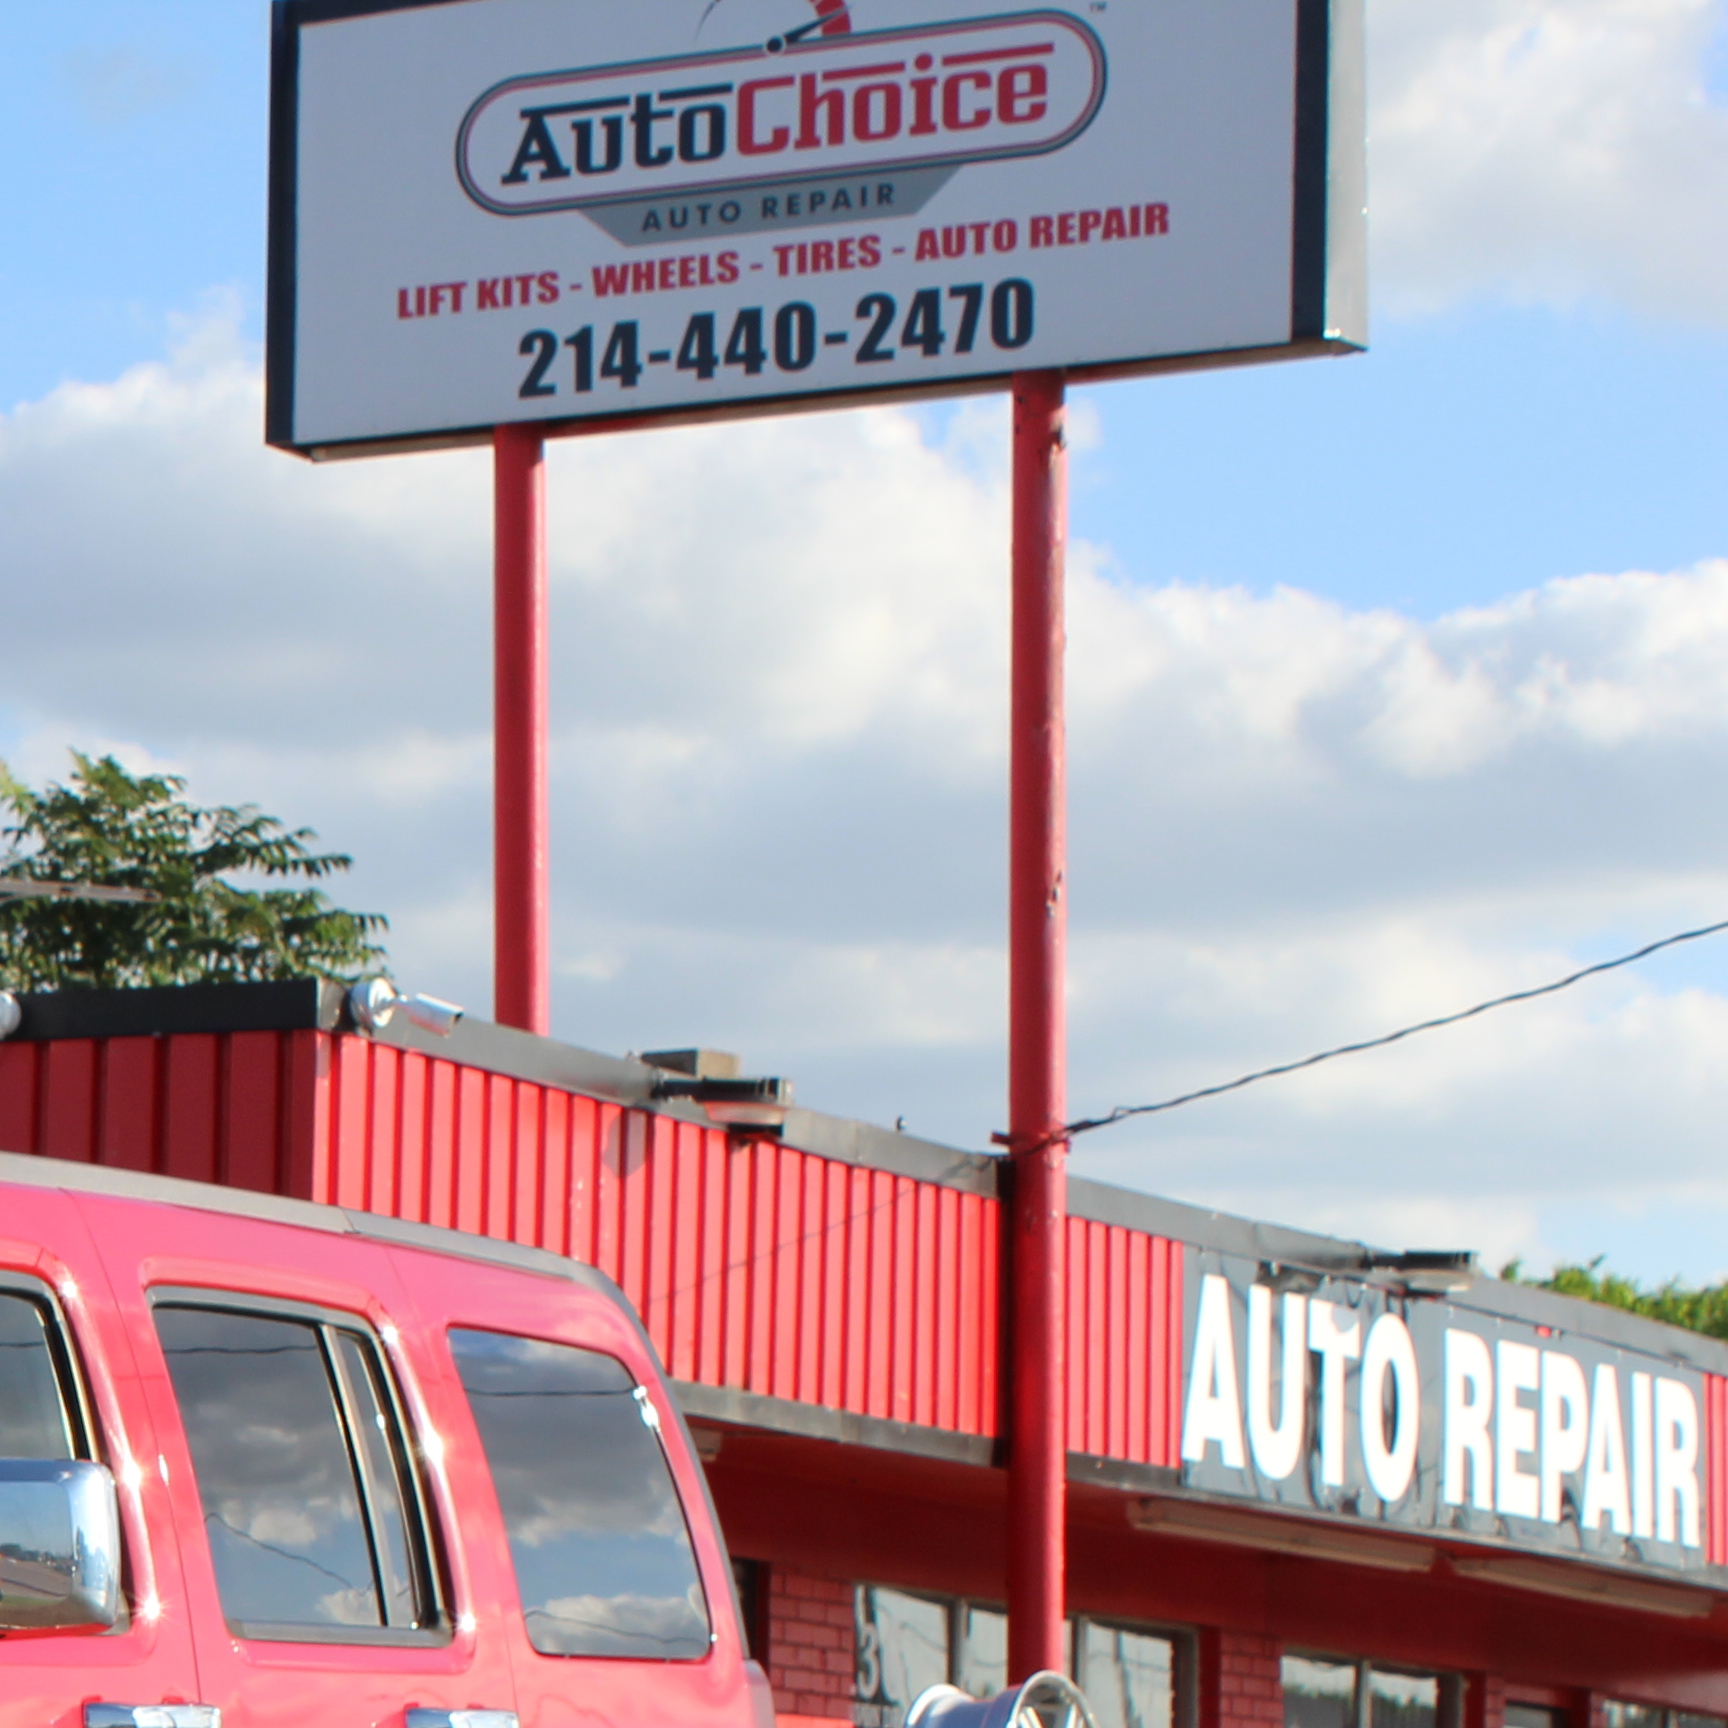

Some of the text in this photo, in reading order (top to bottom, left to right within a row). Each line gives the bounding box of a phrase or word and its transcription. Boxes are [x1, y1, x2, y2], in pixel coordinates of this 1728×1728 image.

[397, 281, 467, 319] LIFT
[477, 270, 561, 311] KITS
[592, 251, 739, 297] WHEELS
[773, 234, 881, 277] TIRES
[915, 219, 1018, 262] AUTO
[1030, 202, 1170, 248] REPAIR
[641, 181, 895, 232] AUTO REPAIR
[518, 277, 1035, 399] 214-440-2470
[1181, 1274, 1701, 1548] AUTO REPAIR
